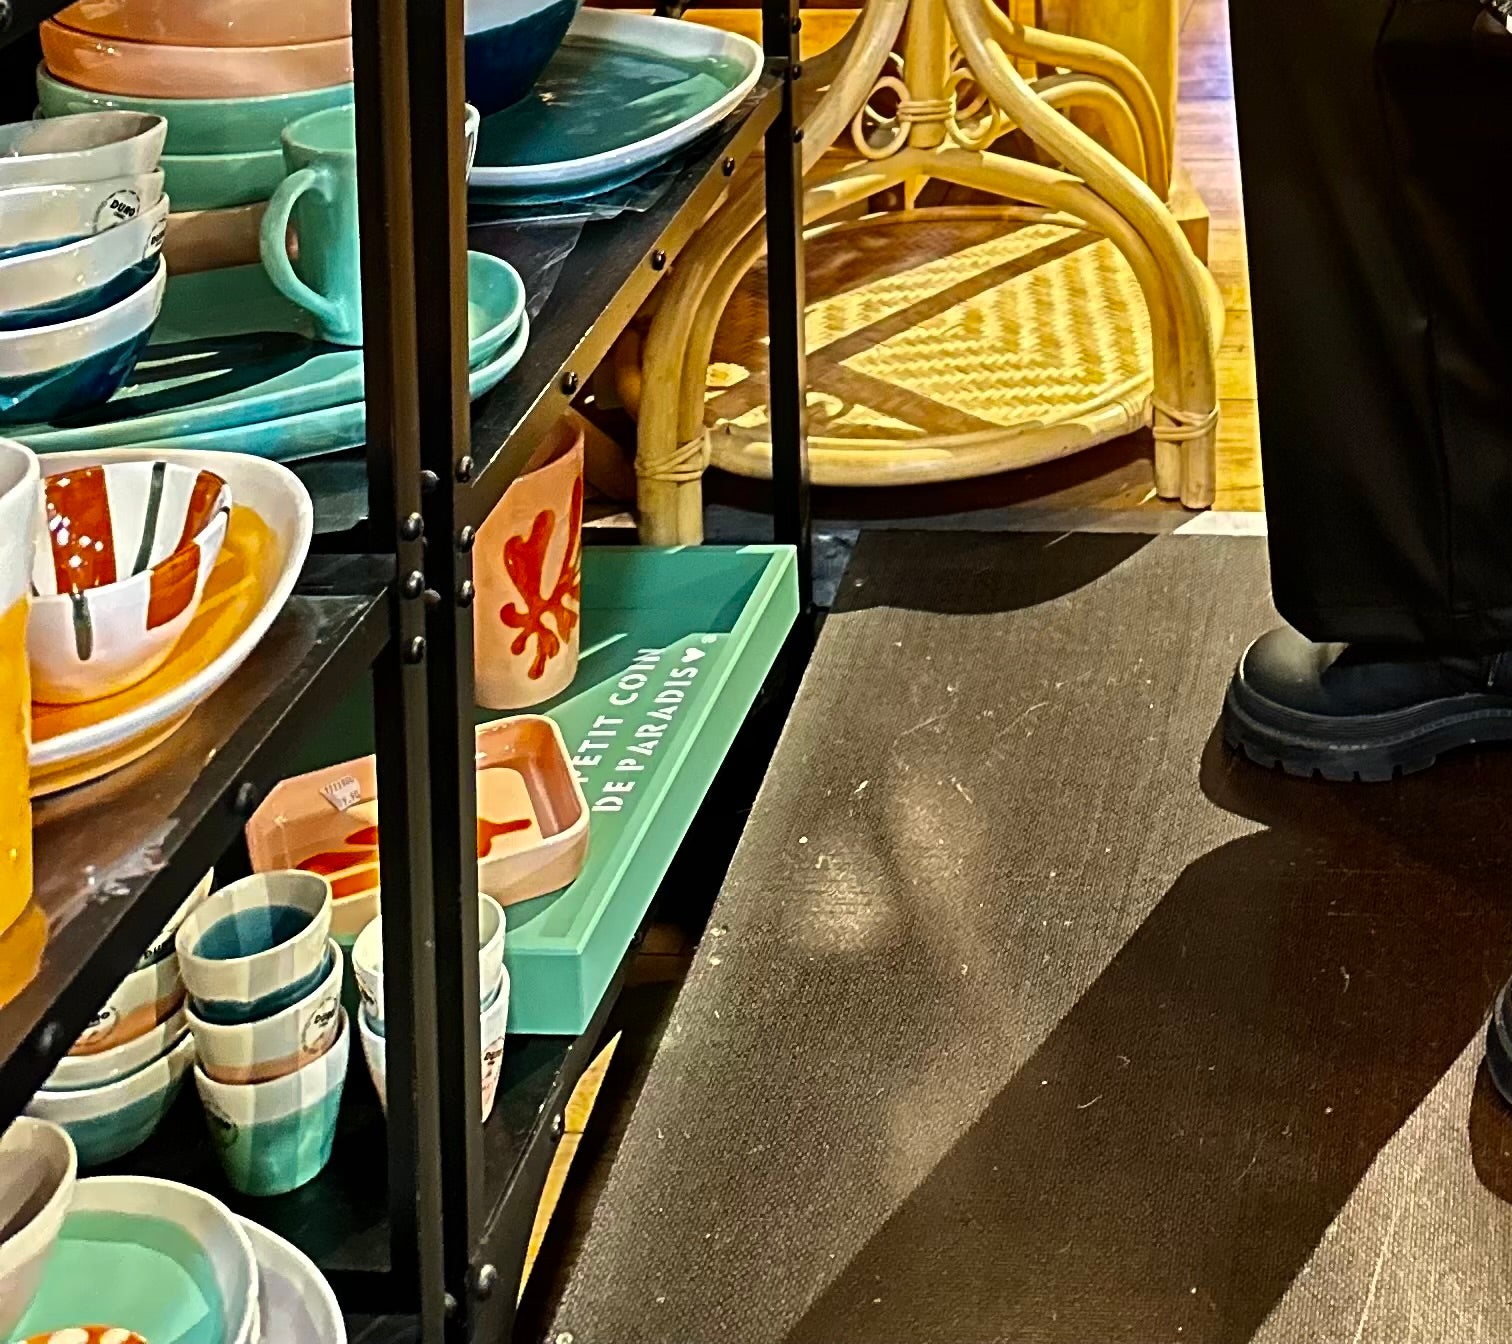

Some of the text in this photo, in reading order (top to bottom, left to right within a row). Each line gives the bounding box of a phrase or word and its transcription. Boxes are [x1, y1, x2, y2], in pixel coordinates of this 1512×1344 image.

[609, 648, 665, 706] COIN
[591, 667, 699, 812] DE PARADIS
